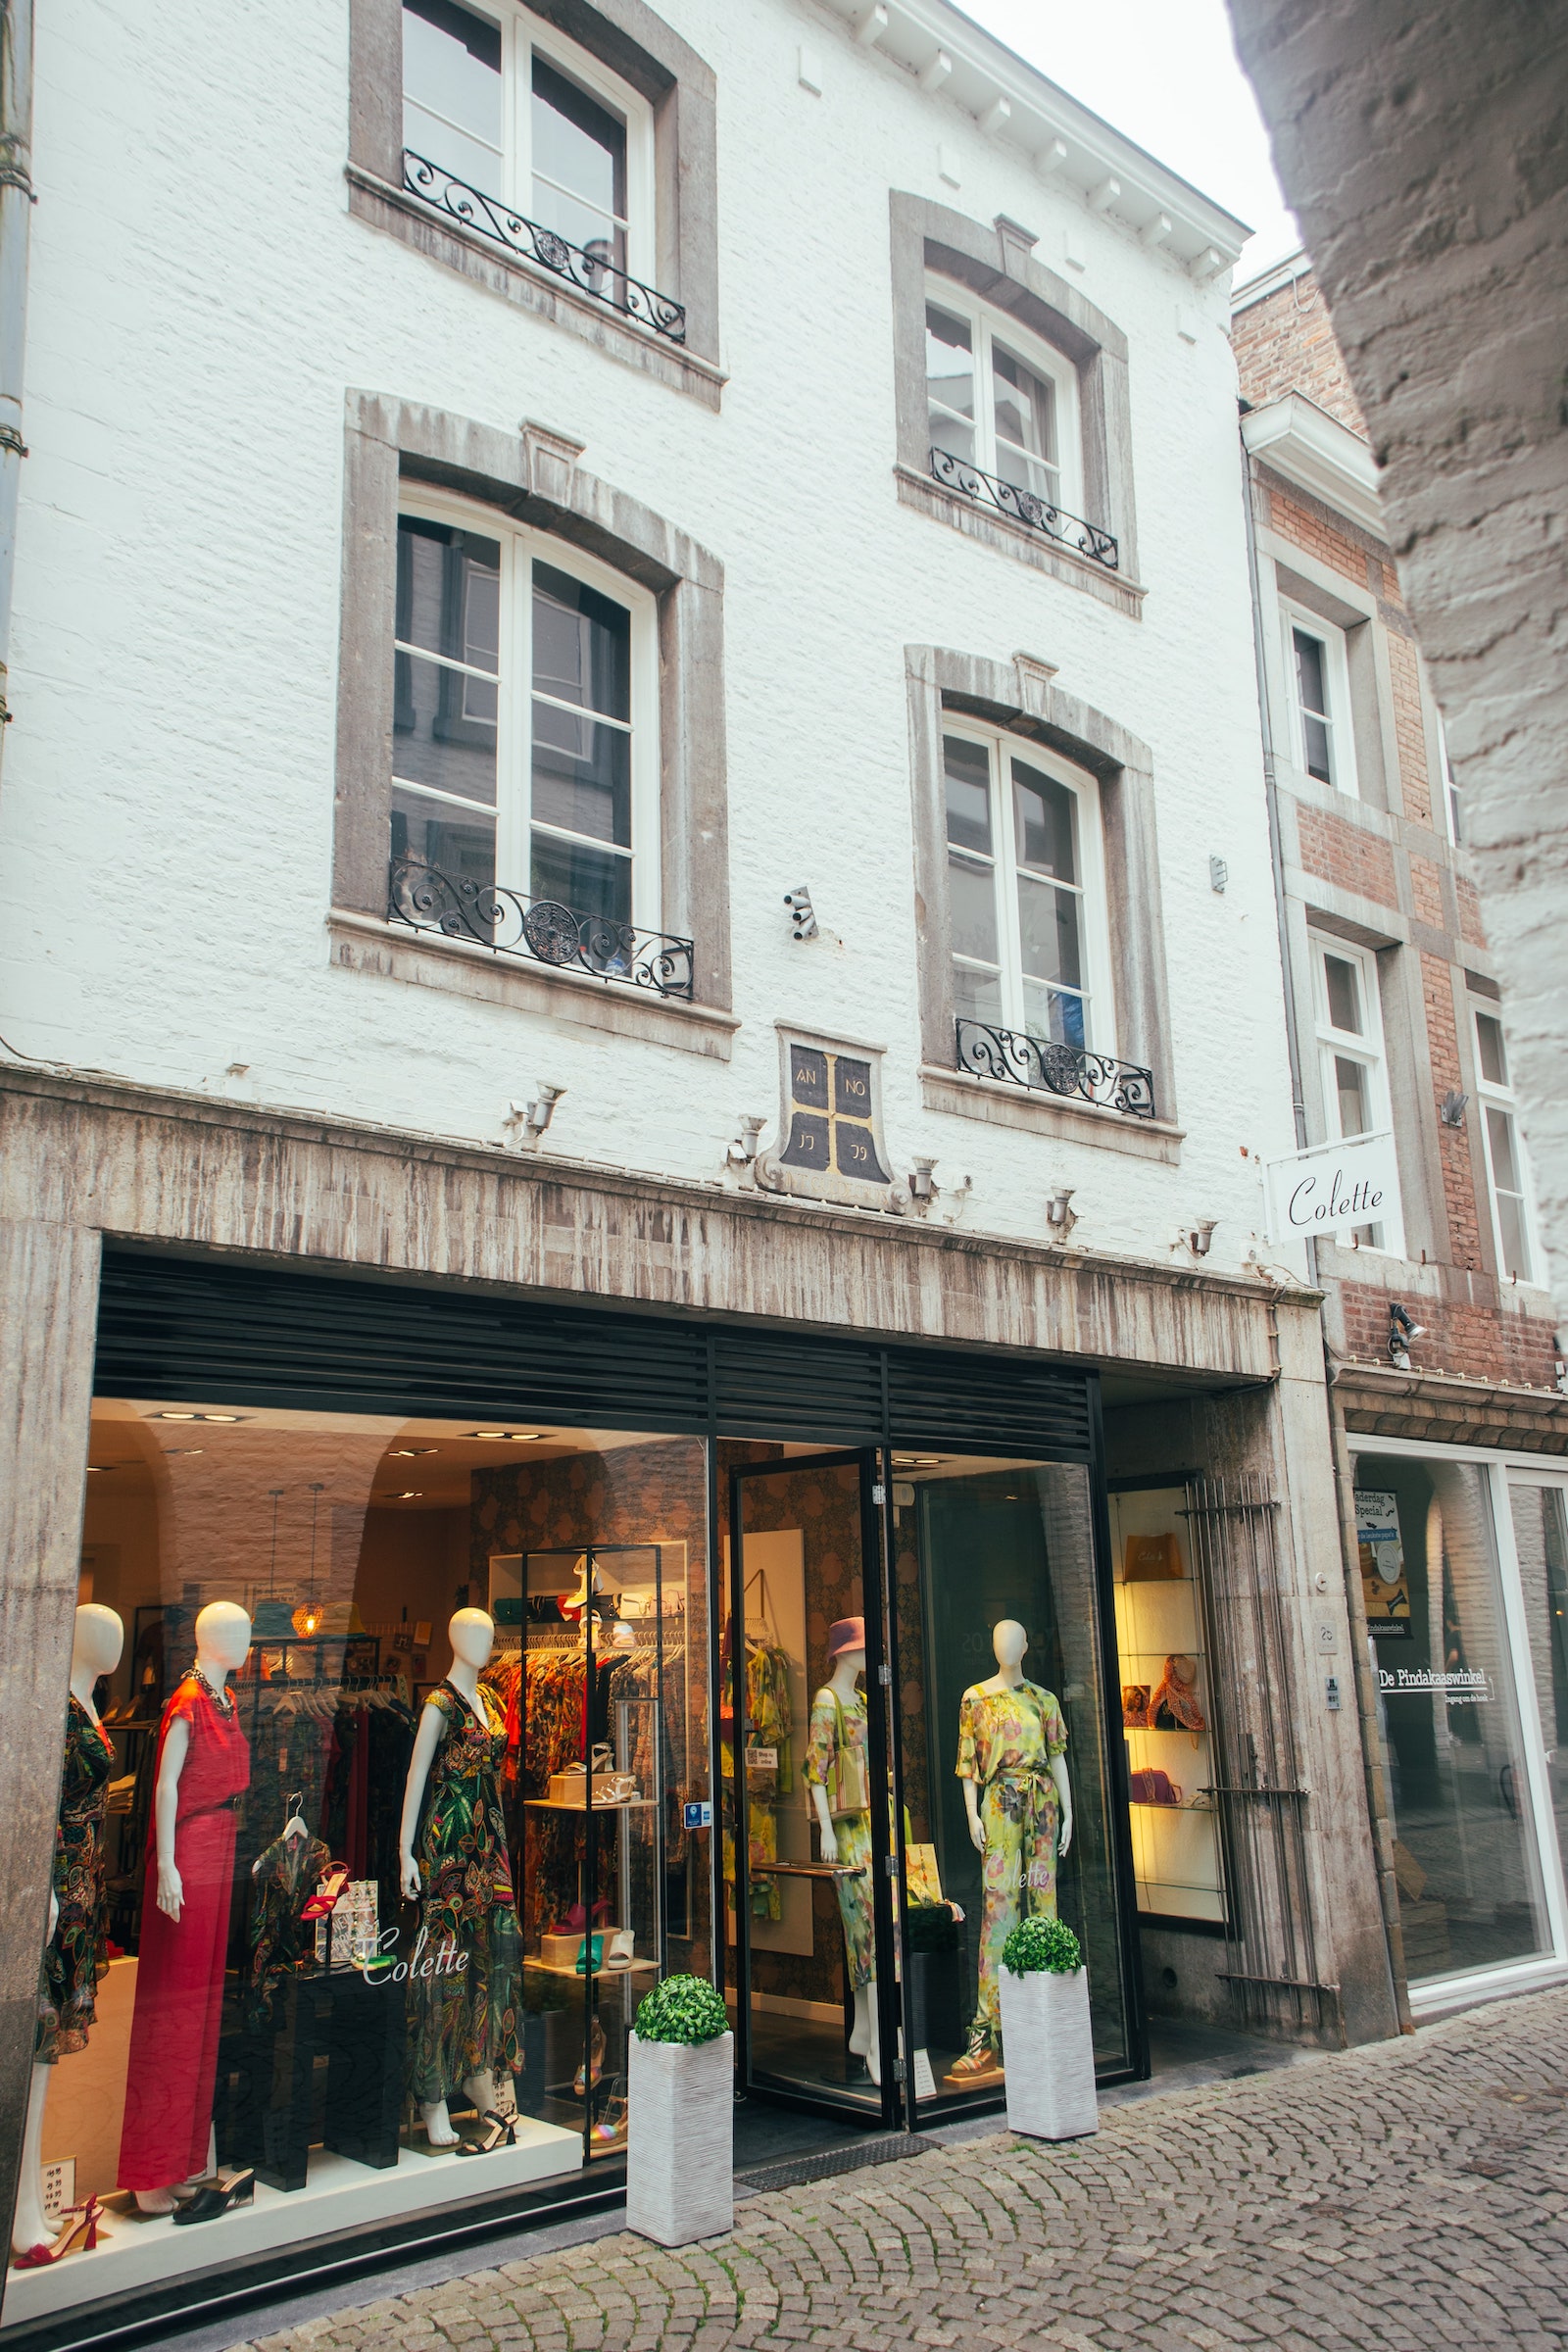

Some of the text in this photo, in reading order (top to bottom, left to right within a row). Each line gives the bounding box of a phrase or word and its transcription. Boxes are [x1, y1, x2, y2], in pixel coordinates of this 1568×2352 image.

[796, 1068, 865, 1096] AN NO
[1289, 1169, 1383, 1226] Colette
[1353, 1491, 1386, 1507] aderdag
[1354, 1503, 1384, 1518] Special
[1378, 1668, 1487, 1687] De Pindakaaswinkel
[985, 1847, 1049, 1892] Colette
[363, 1926, 469, 1985] Colette
